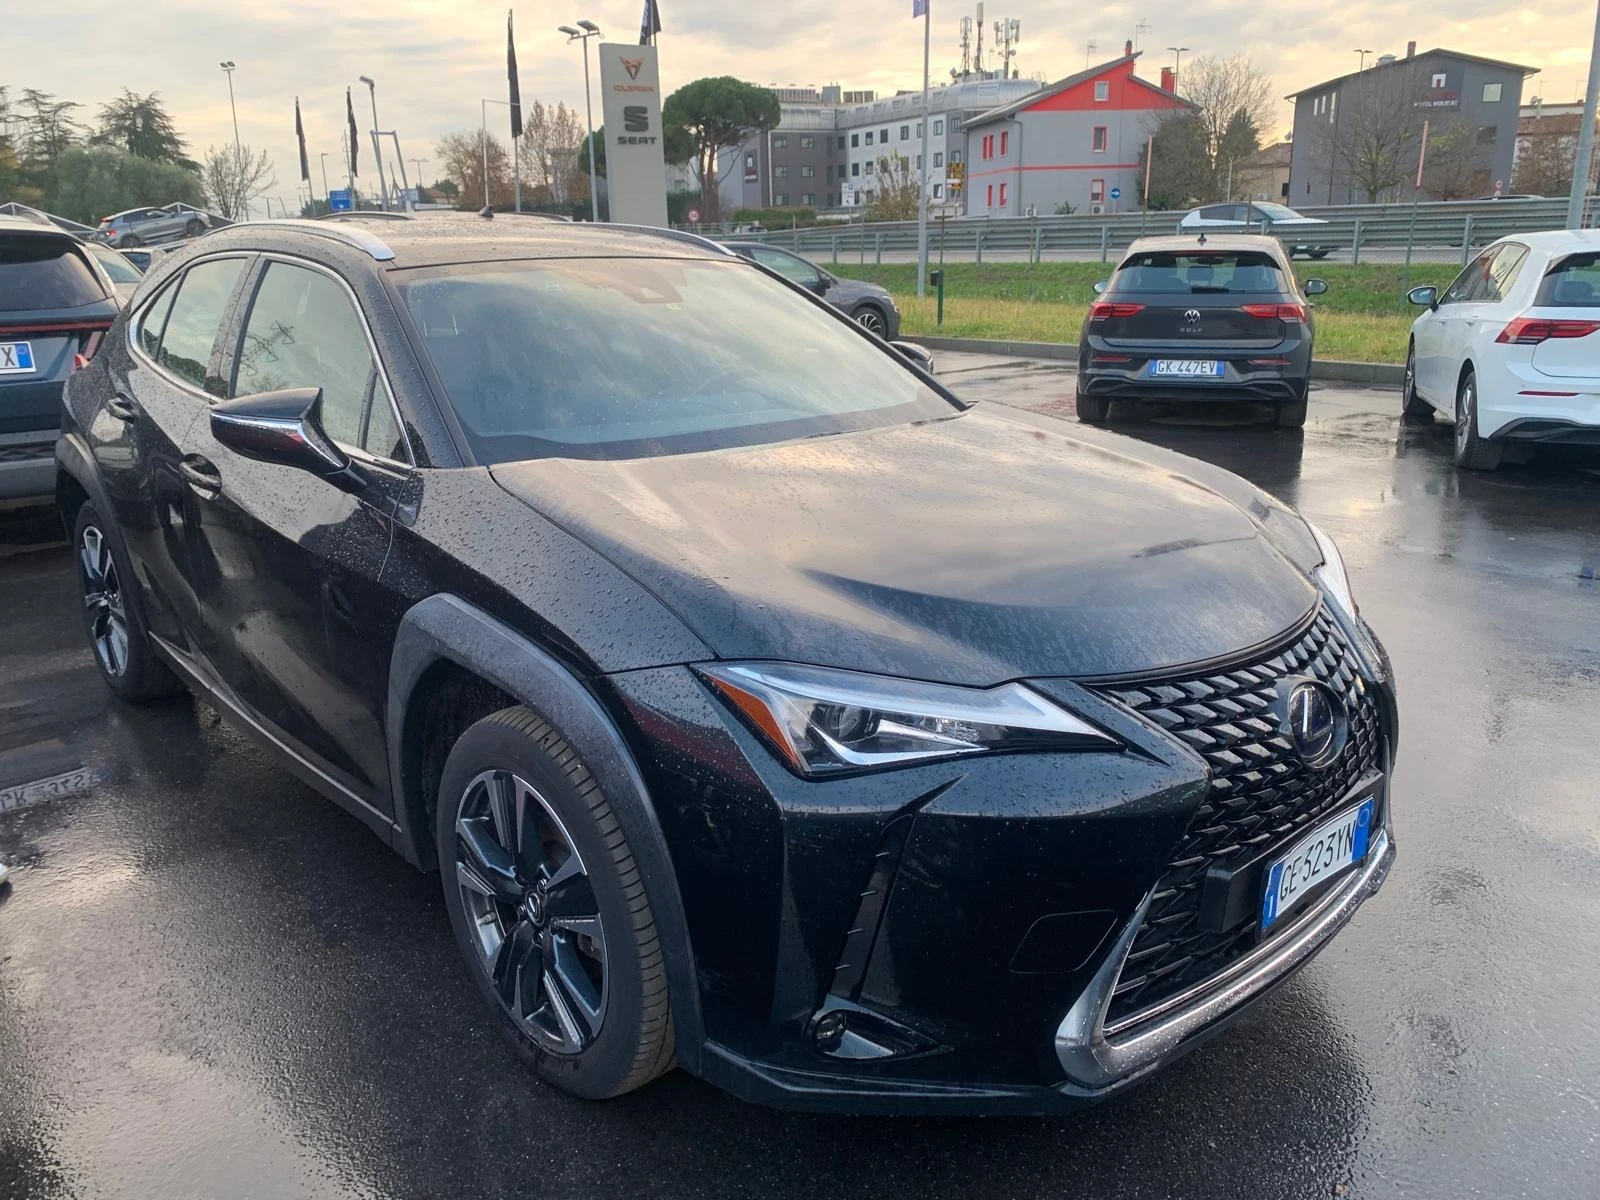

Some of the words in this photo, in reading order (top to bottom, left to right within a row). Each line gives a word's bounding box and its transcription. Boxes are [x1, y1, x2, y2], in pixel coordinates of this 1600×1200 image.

[617, 136, 657, 145] SEAT
[1158, 360, 1173, 373] GK
[1177, 360, 1216, 373] 447EV
[1279, 855, 1303, 901] GE
[1302, 818, 1357, 882] 323YN
